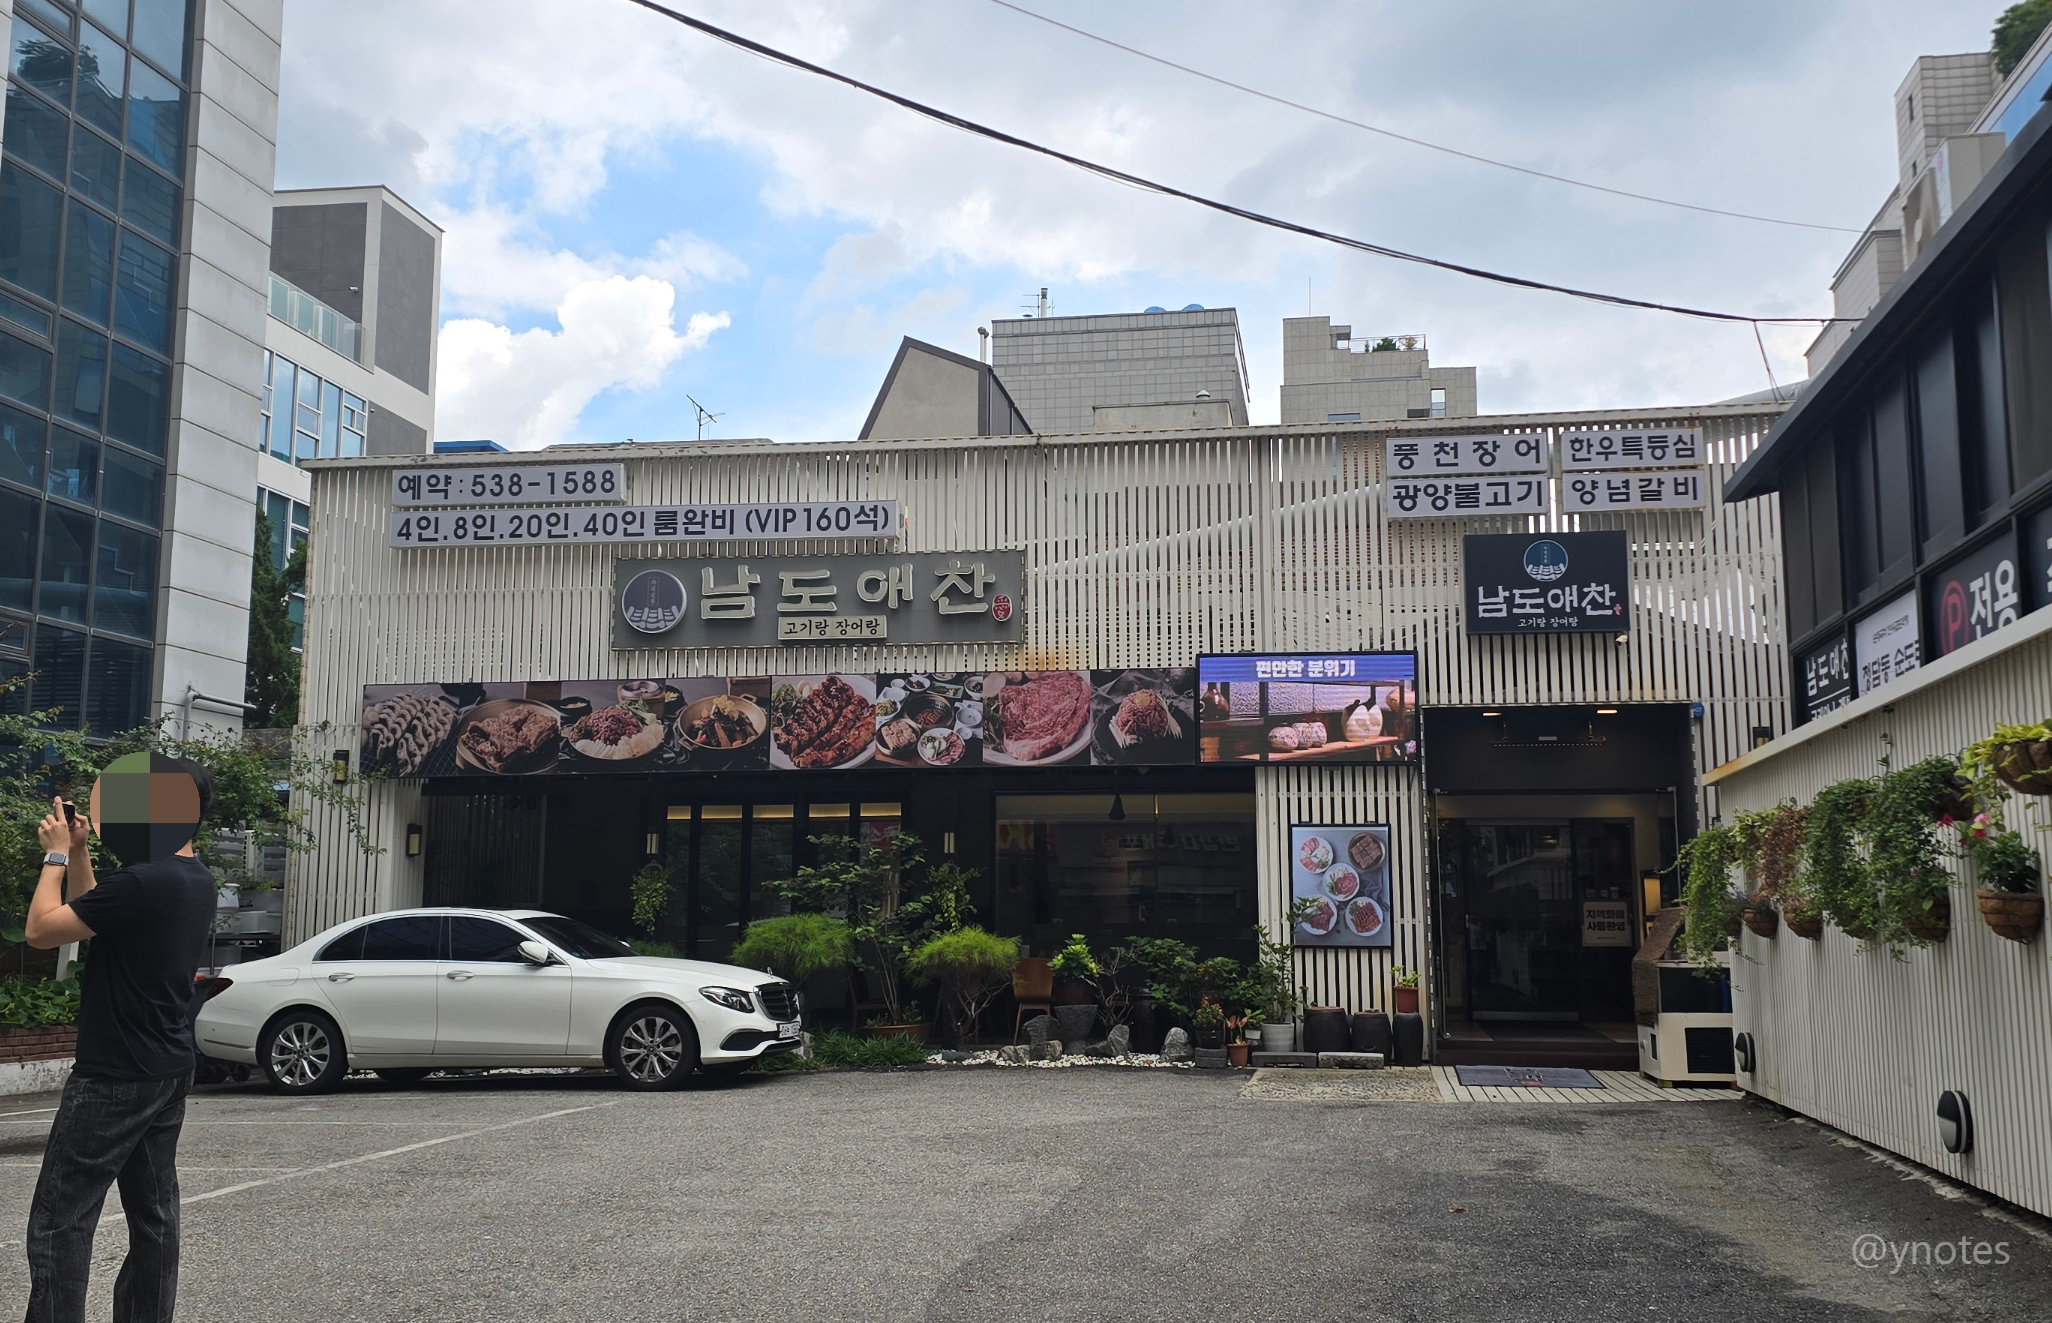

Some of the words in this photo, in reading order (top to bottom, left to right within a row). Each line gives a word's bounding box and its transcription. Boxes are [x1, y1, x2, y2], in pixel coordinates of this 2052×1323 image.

[1393, 439, 1541, 471] 풍천장어
[1569, 433, 1696, 463] 한우특등심
[397, 469, 615, 500] 예약:538-1588
[1393, 480, 1543, 512] 광양불고기
[1571, 476, 1698, 506] 양념갈비
[701, 560, 996, 620] 남도애찬
[1477, 582, 1617, 618] 남도애찬
[783, 619, 830, 637] 고기랑
[834, 617, 881, 636] 장어랑
[1517, 616, 1547, 628] 고기랑
[1549, 615, 1579, 628] 장어랑
[1307, 659, 1356, 678] 분위기
[1861, 653, 1891, 692] 청담동
